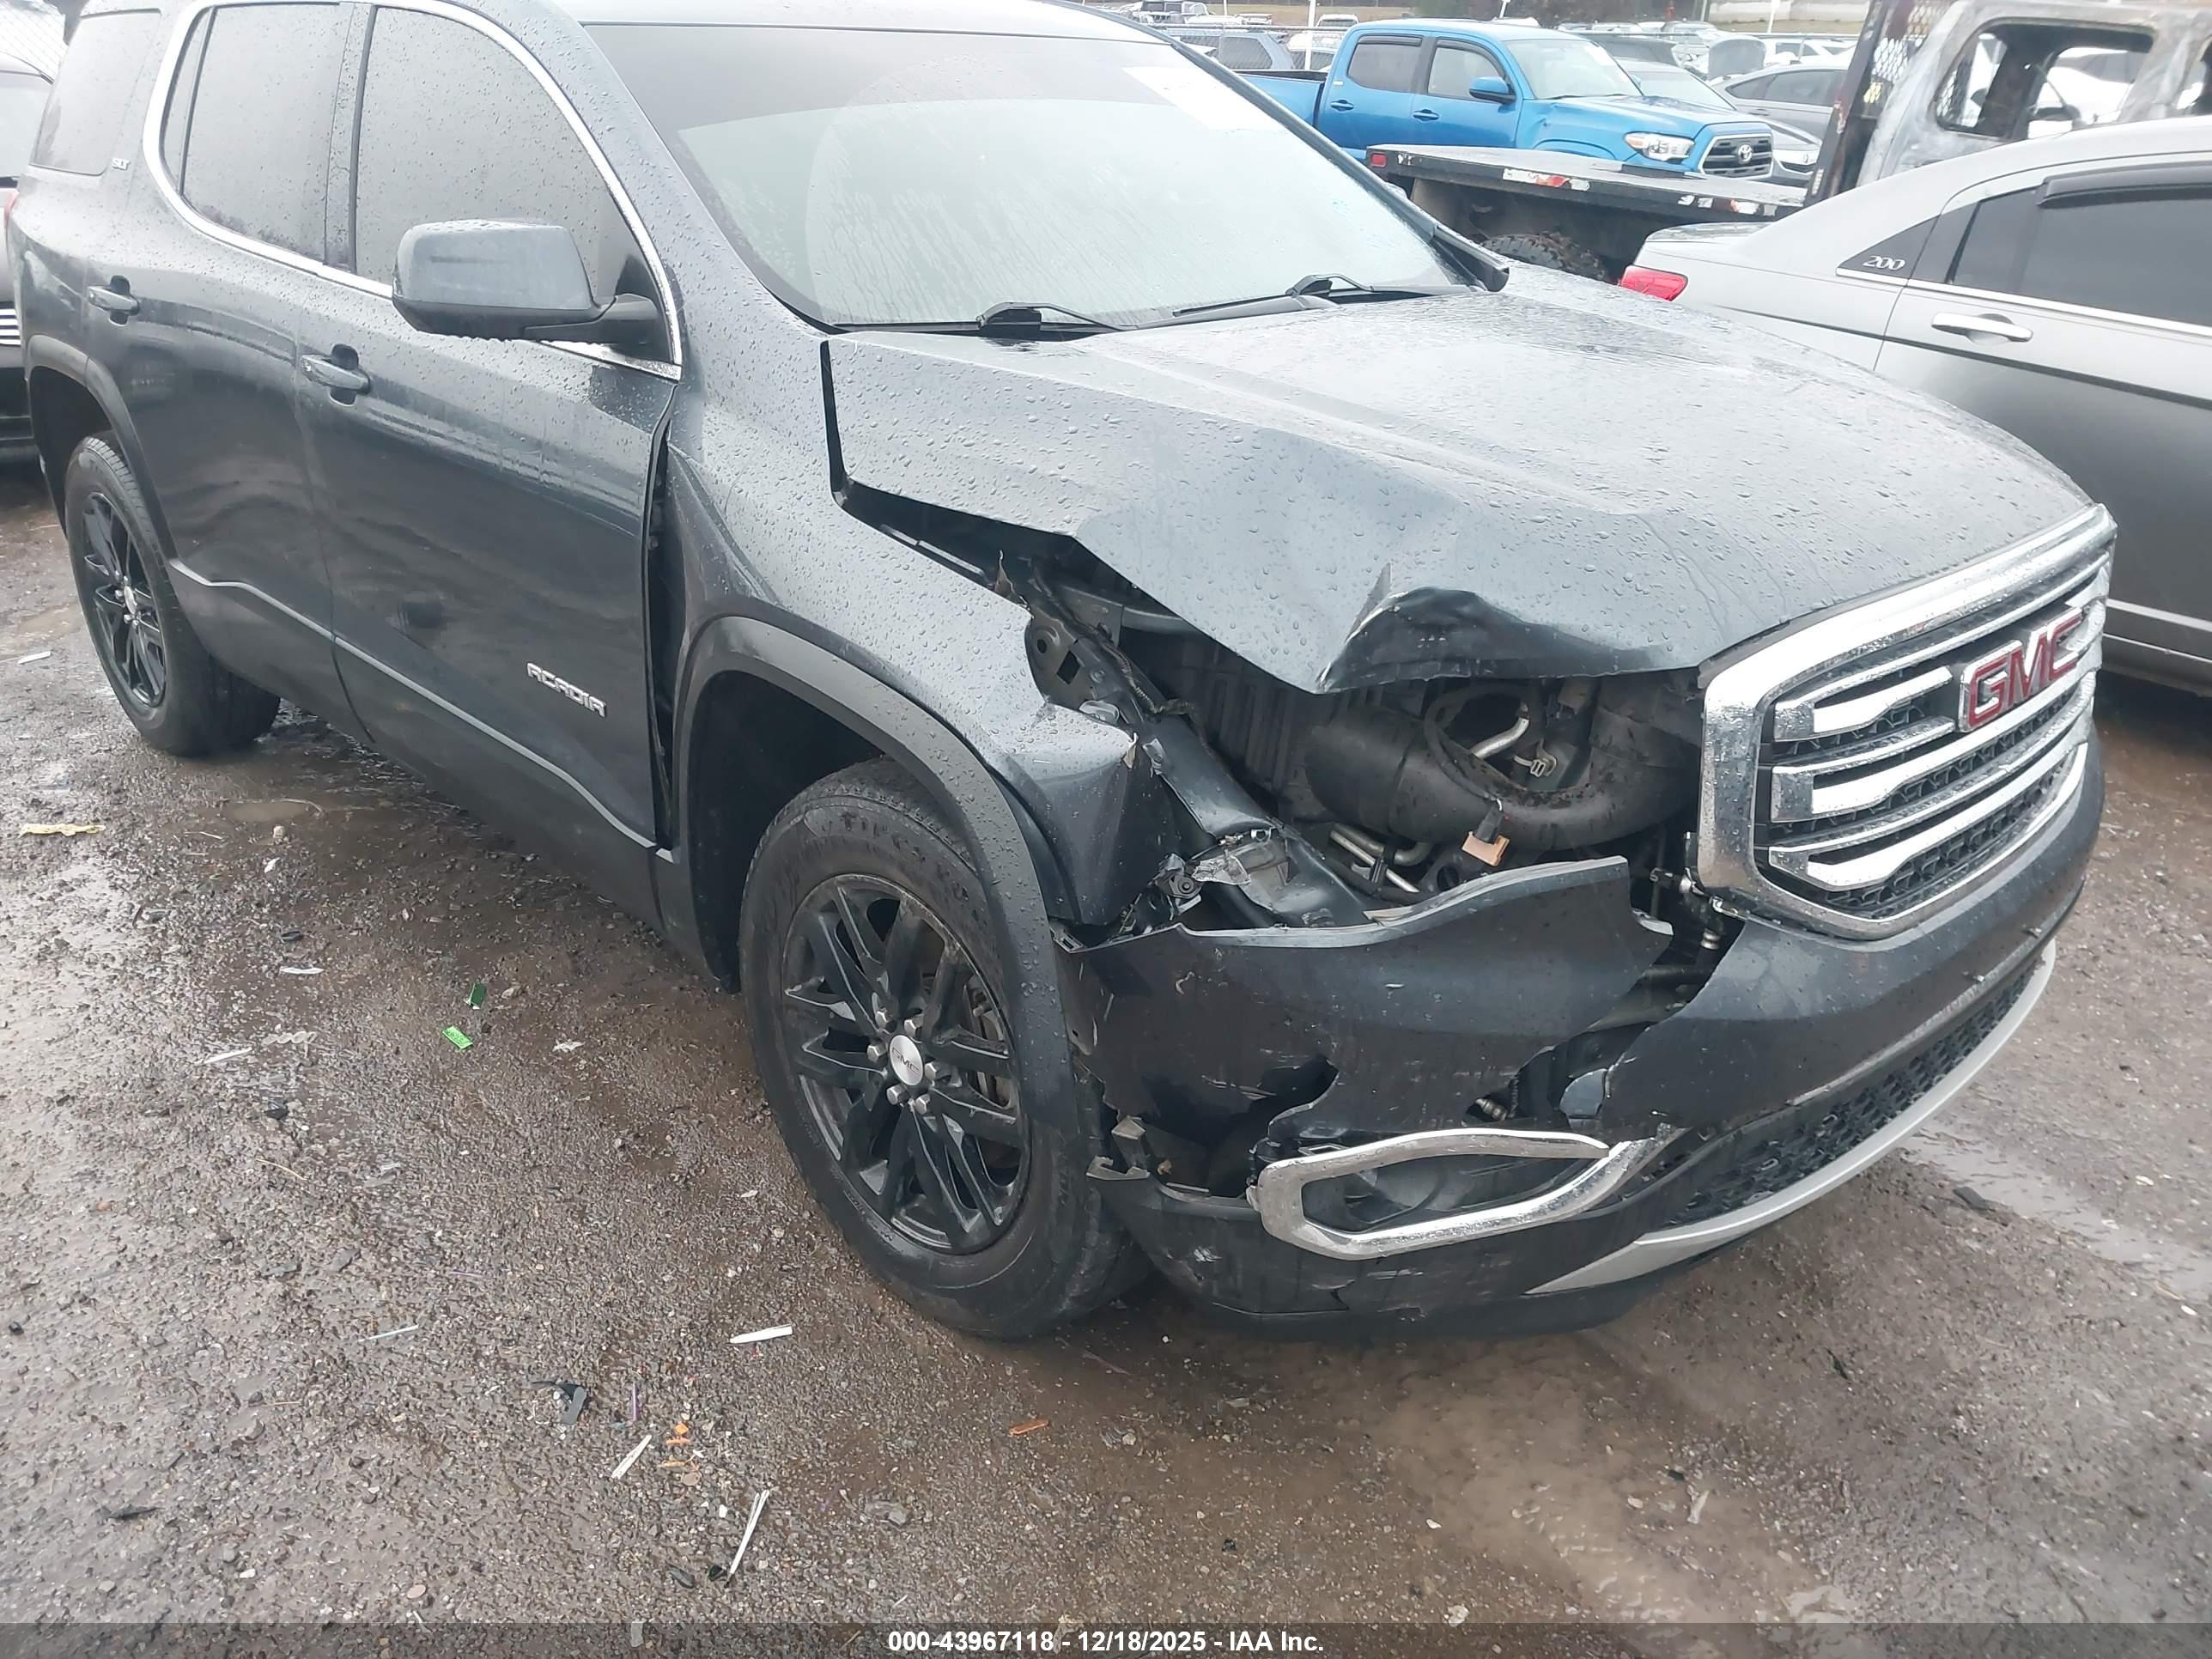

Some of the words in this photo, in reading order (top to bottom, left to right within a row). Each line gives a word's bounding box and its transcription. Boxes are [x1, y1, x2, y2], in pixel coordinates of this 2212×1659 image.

[1862, 255, 1905, 271] 200
[526, 662, 606, 718] ACADIA
[1959, 606, 2083, 732] GMC
[892, 1047, 921, 1077] GMC
